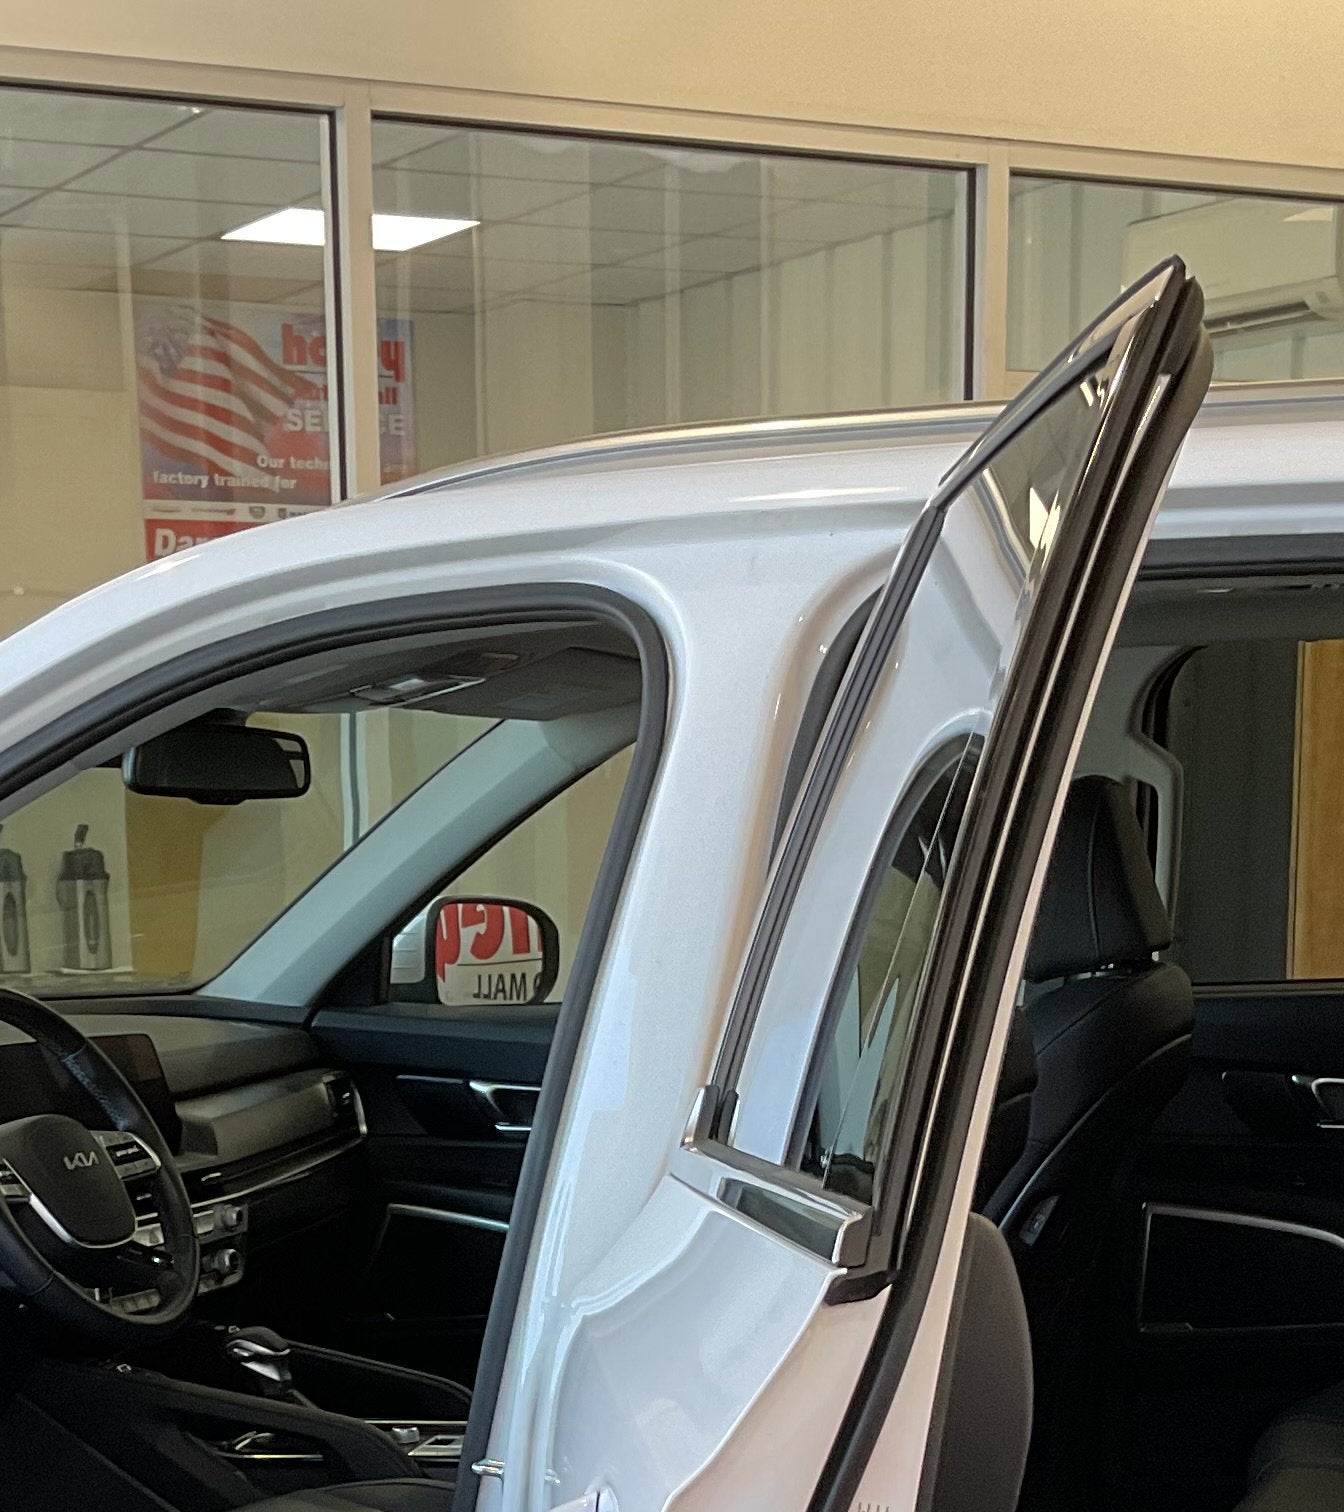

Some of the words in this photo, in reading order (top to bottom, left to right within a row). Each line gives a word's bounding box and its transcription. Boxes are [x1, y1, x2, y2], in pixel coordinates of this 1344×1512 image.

[256, 454, 285, 469] Our
[153, 470, 210, 488] factory
[214, 472, 269, 488] trained
[273, 474, 297, 489] for
